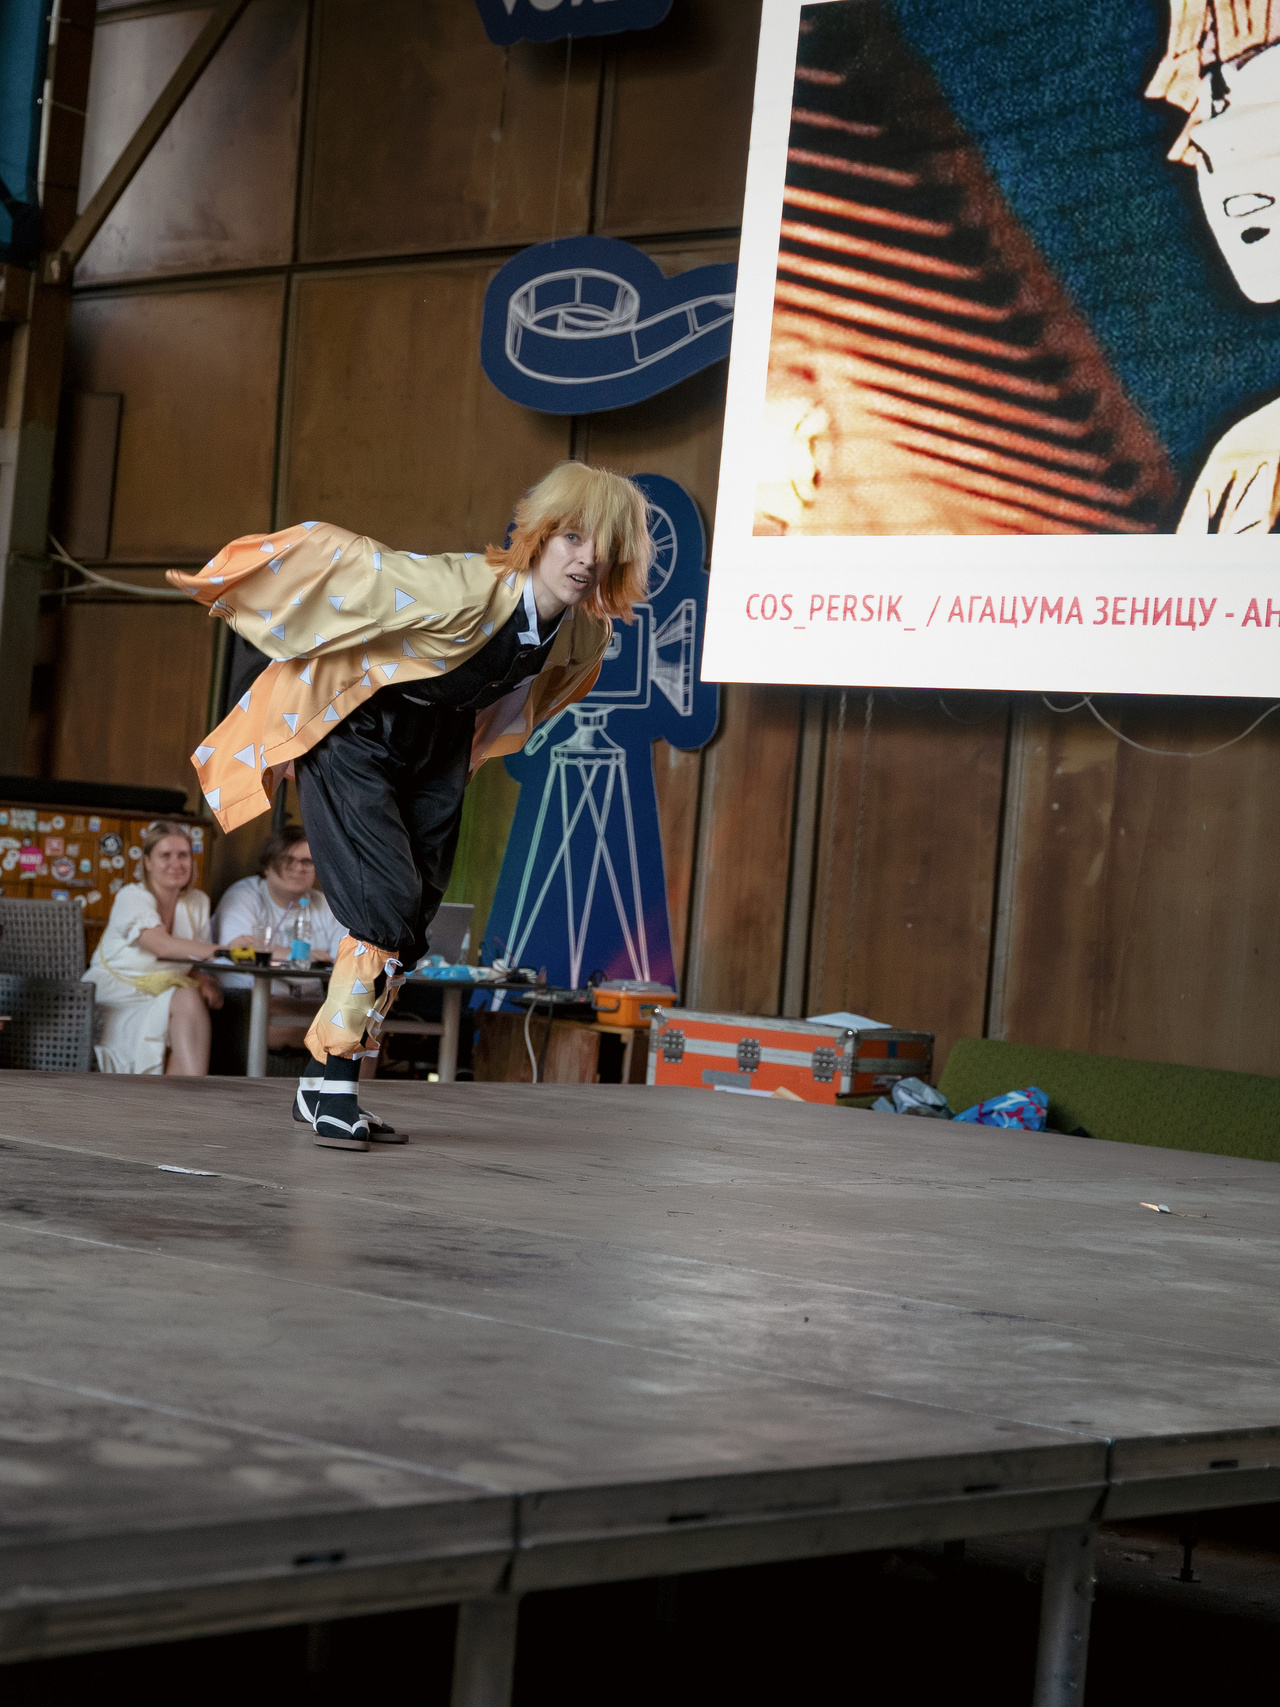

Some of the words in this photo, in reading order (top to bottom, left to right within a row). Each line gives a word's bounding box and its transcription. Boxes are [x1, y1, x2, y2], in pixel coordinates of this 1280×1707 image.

[745, 593, 917, 631] COS_PERSIK_
[926, 595, 942, 627] /
[947, 595, 1084, 629] АГАЦУМА
[1092, 595, 1218, 632] ЗЕНИЦУ
